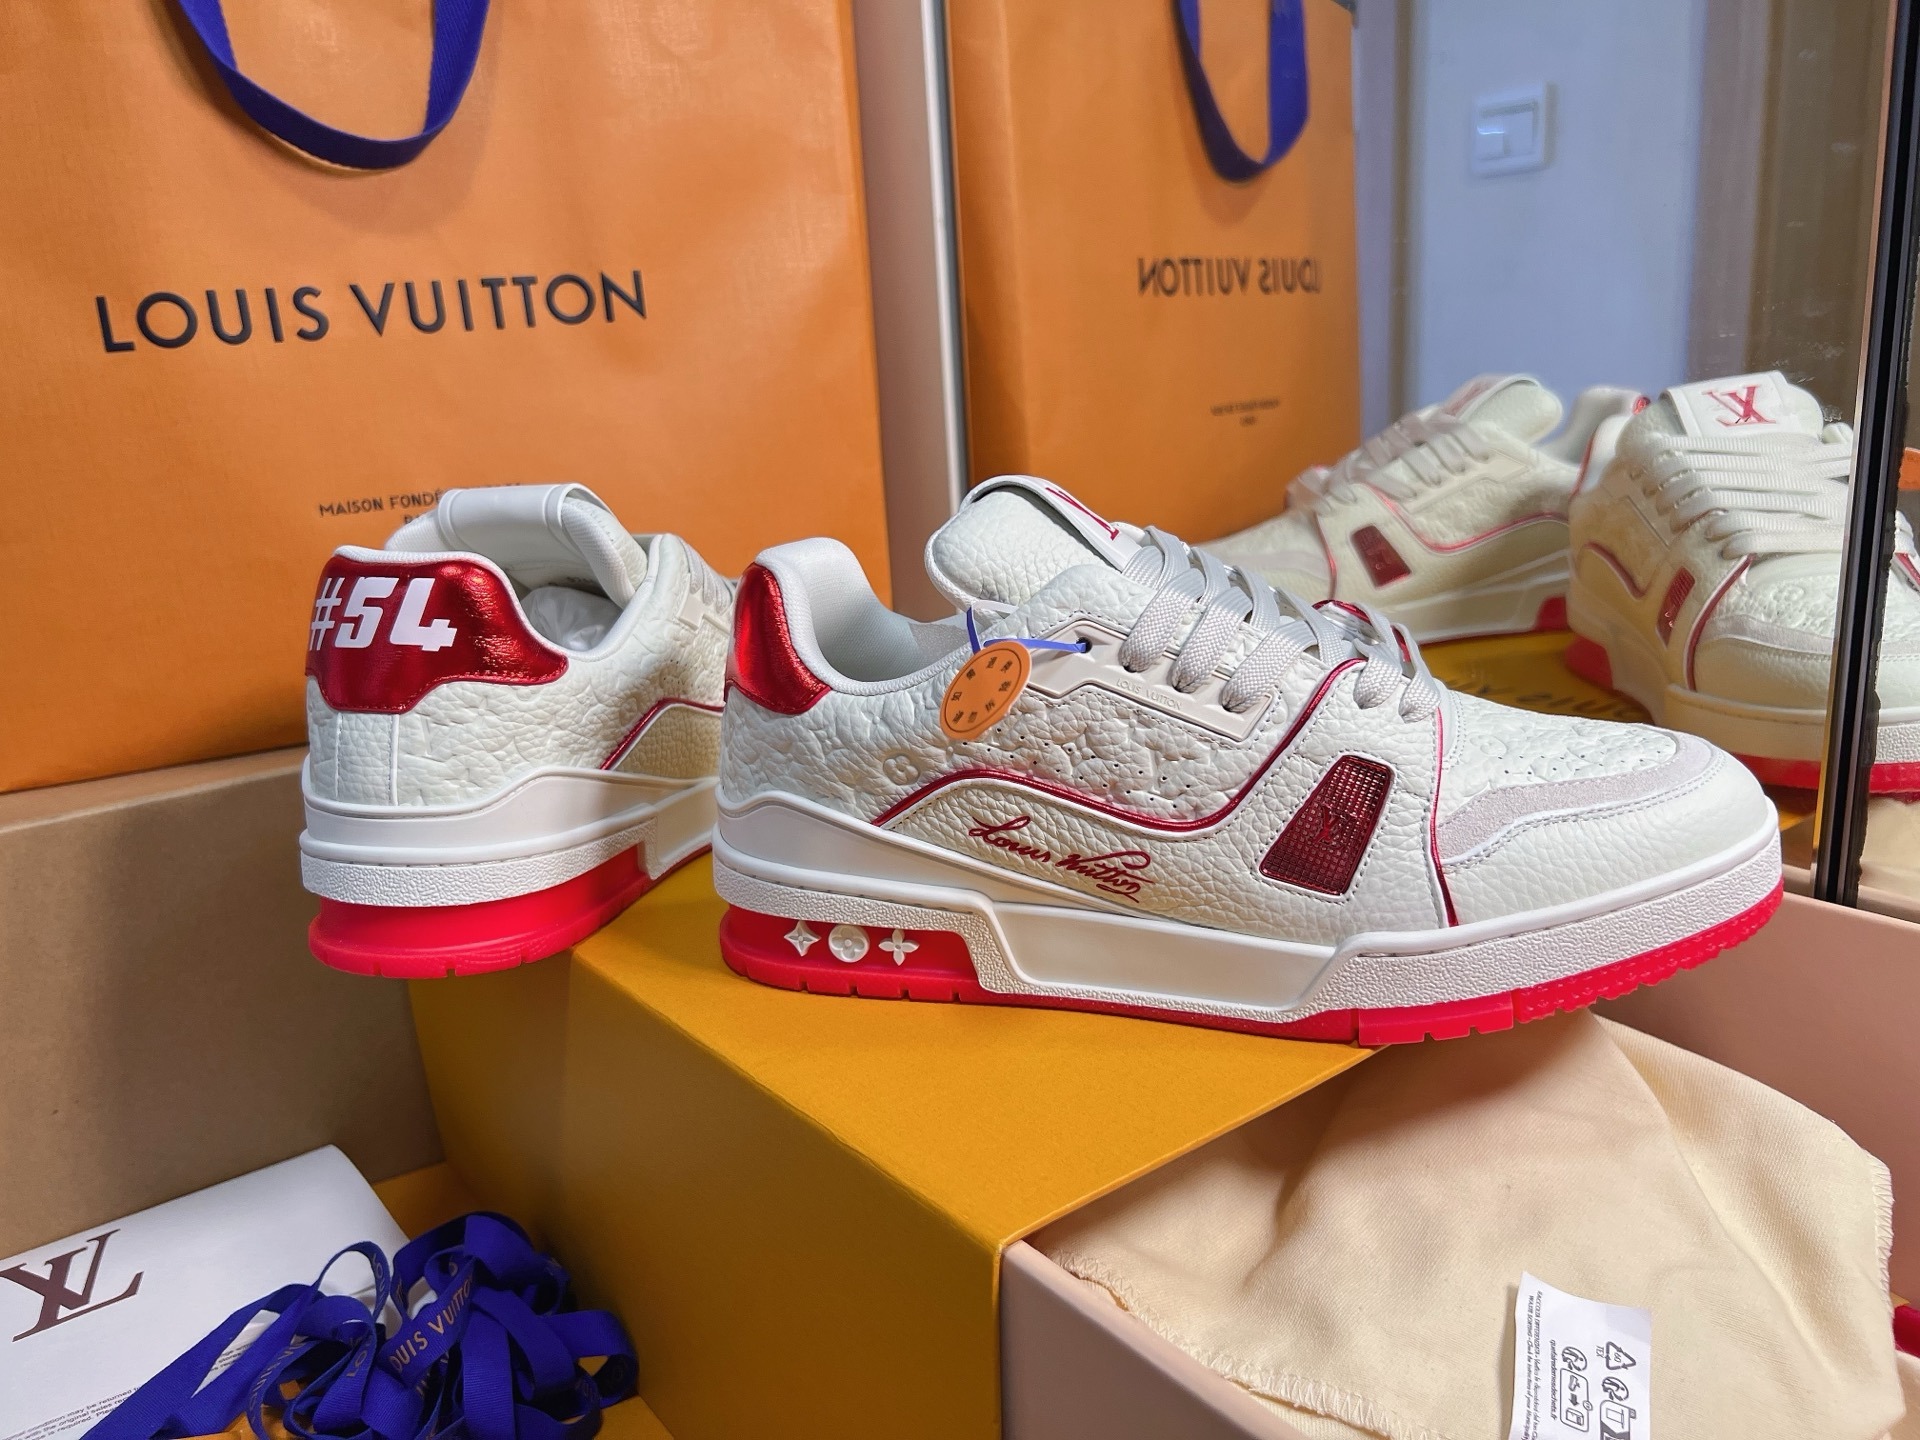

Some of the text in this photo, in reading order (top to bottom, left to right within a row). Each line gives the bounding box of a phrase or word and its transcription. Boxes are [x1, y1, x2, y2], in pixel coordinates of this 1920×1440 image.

[96, 270, 647, 353] LOUIS VUITTON
[319, 488, 445, 517] MAISON FONDÉ
[310, 577, 458, 652] #54
[968, 815, 1155, 903] Louis Vuitton
[1534, 1290, 1542, 1318] RACCOLTA
[389, 1331, 428, 1374] OUIS
[1595, 1345, 1606, 1359] TEX
[1613, 1352, 1622, 1363] 60
[27, 1415, 66, 1432] condition
[66, 1408, 84, 1417] may
[99, 1389, 132, 1405] returned
[43, 1424, 56, 1432] the
[58, 1411, 90, 1426] original
[91, 1403, 112, 1414] sales
